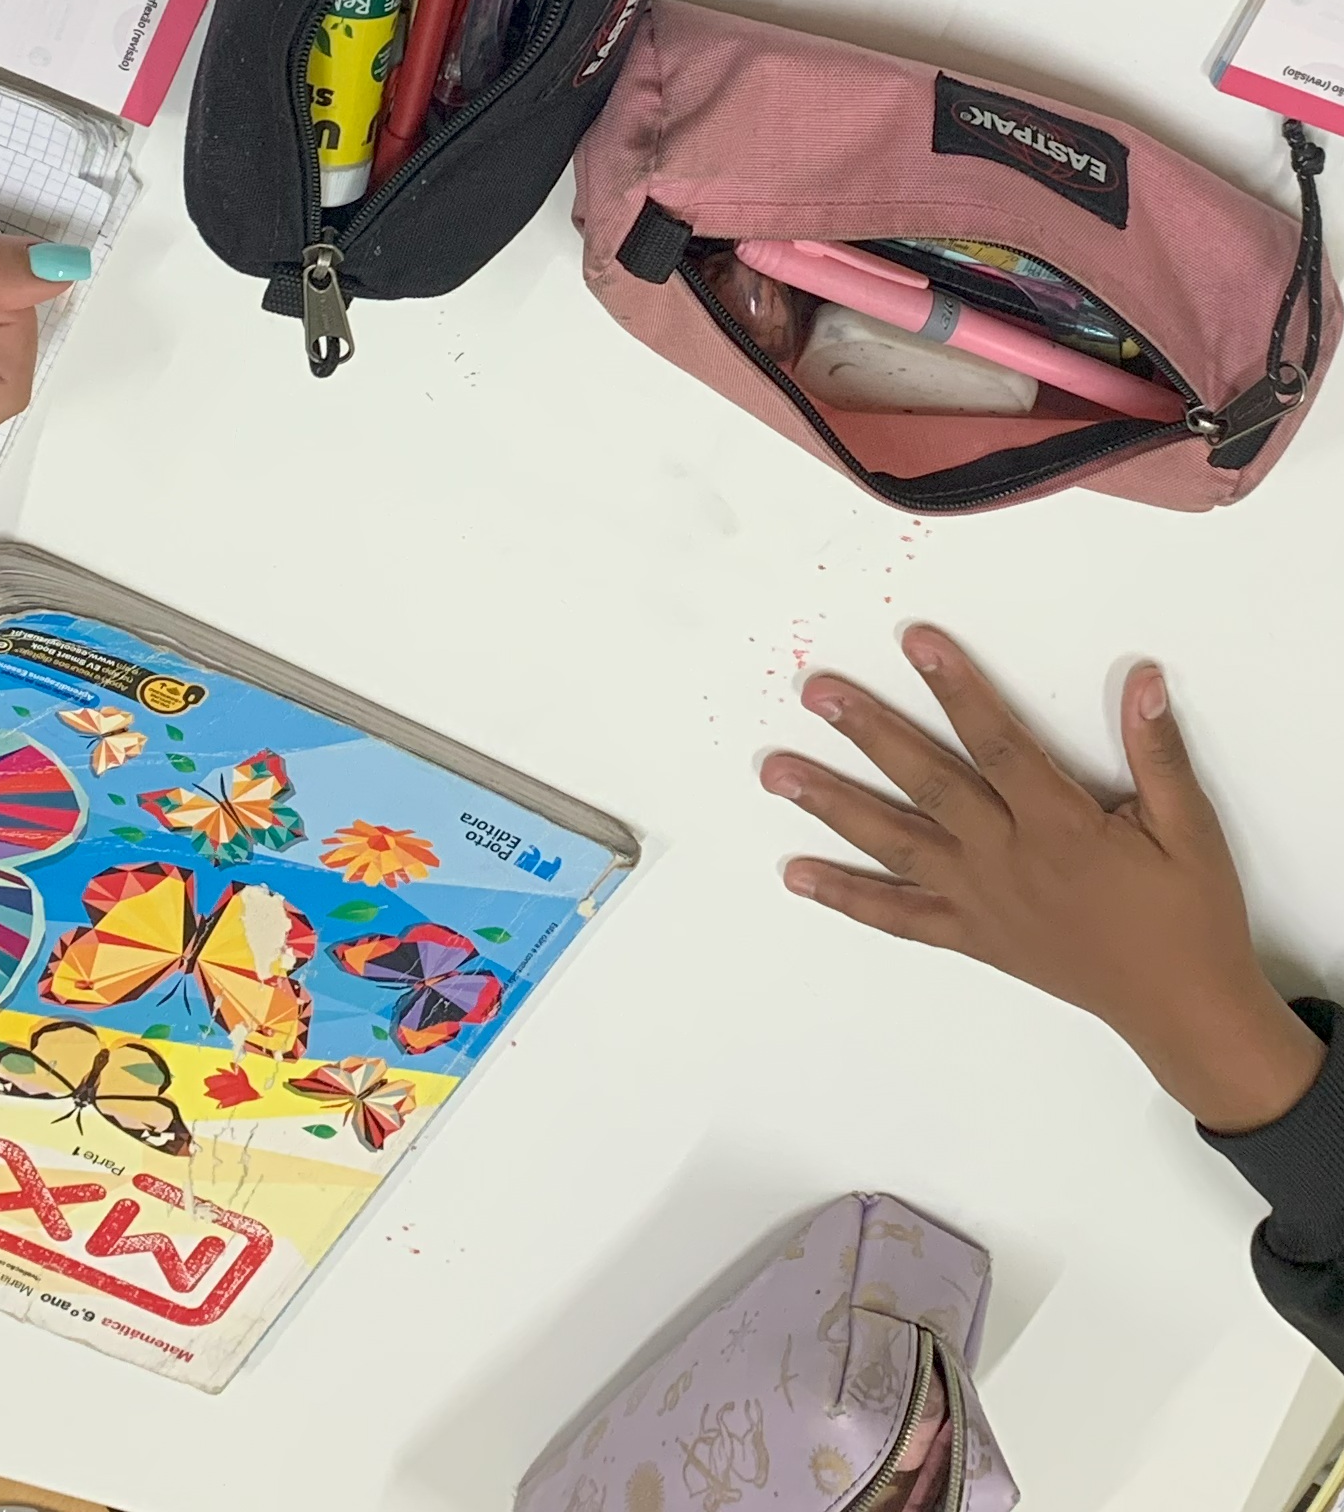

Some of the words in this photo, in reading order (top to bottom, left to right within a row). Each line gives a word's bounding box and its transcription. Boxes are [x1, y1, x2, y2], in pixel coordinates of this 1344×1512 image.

[117, 28, 145, 71] (revisão)
[1282, 65, 1331, 91] (revisão)
[963, 105, 1106, 182] EASTPAK
[459, 812, 521, 849] Editora
[465, 830, 513, 861] Porto
[71, 1145, 80, 1156] 1
[83, 1150, 125, 1176] Parte
[0, 1273, 34, 1296] Maria
[39, 1292, 71, 1310] ano
[69, 1307, 95, 1322] 6.º
[100, 1317, 194, 1363] Matemática
